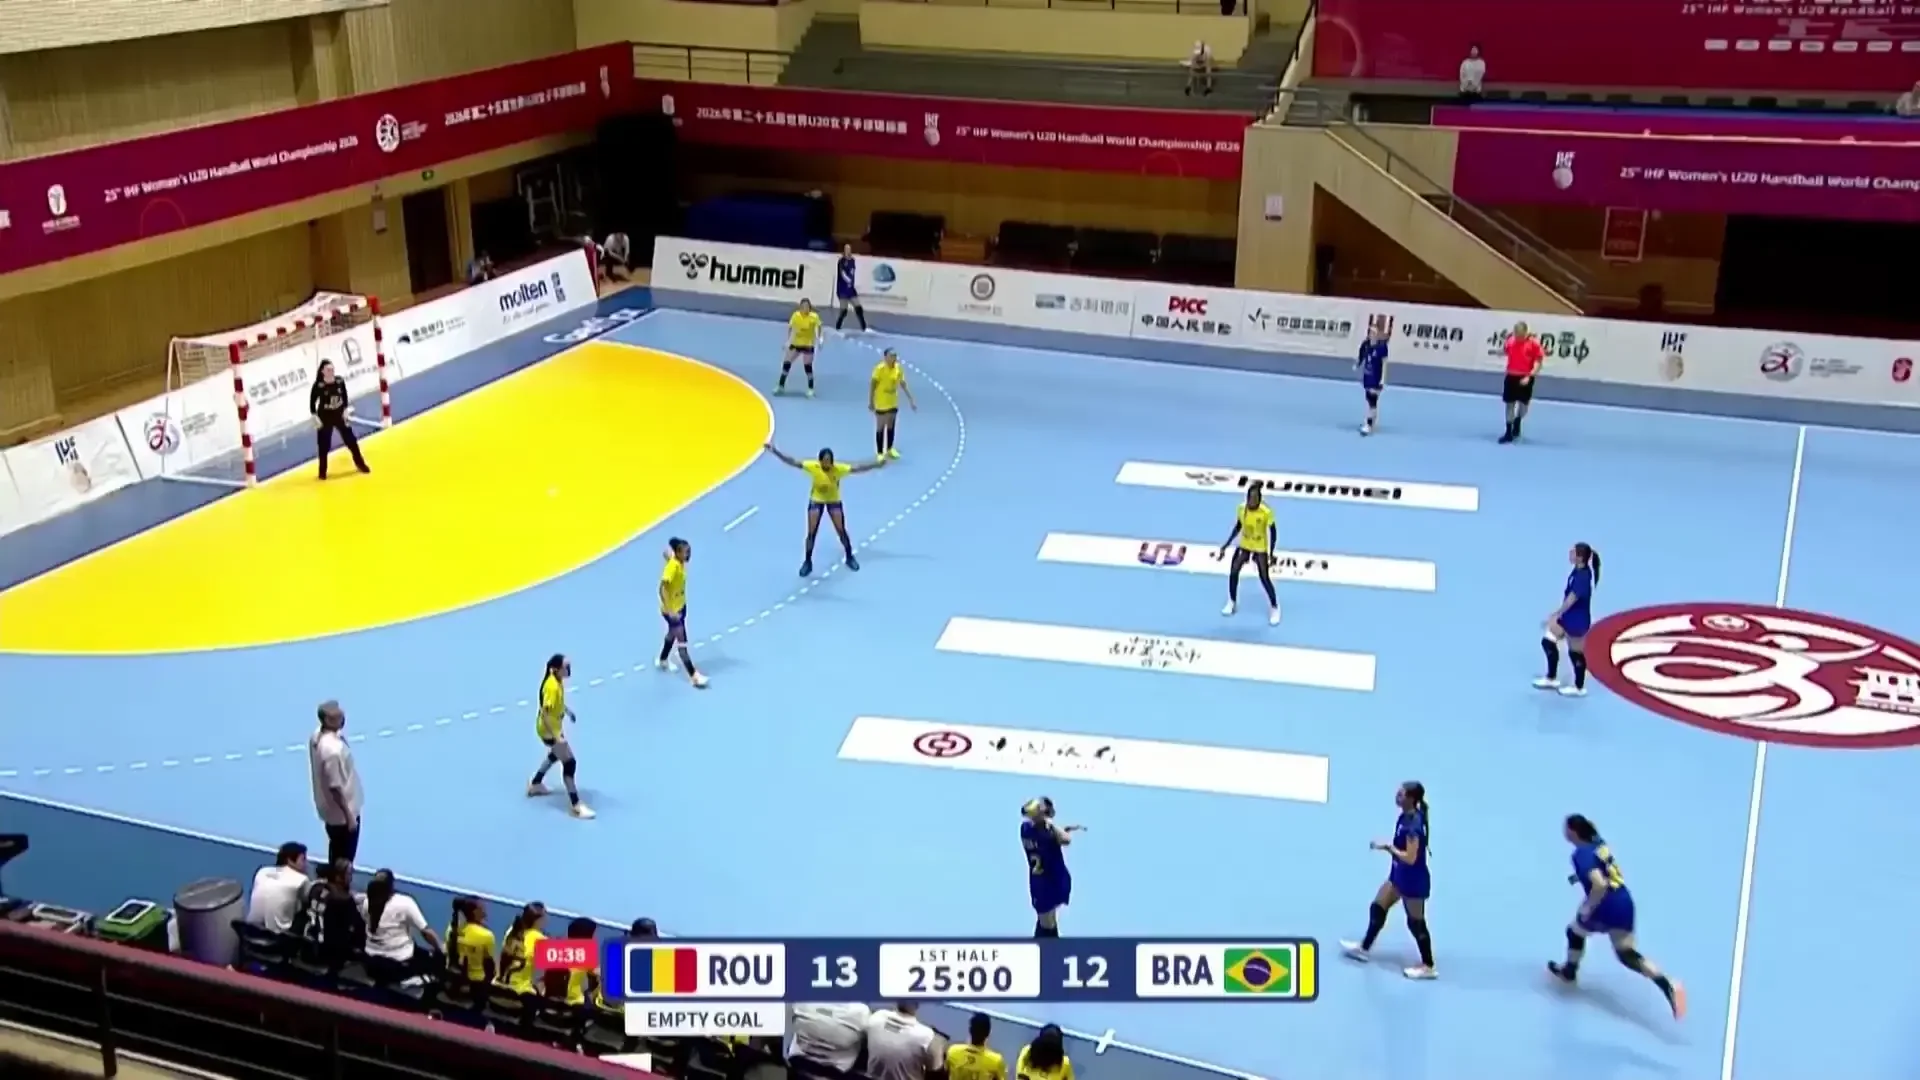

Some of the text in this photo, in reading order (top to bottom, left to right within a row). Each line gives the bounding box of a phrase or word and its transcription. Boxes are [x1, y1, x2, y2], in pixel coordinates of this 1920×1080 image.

[1058, 132, 1103, 145] Handball
[1106, 134, 1136, 147] World
[1138, 136, 1212, 153] Championship
[209, 158, 251, 180] Handball
[251, 151, 278, 169] World
[279, 139, 338, 163] Championship
[1644, 167, 1665, 180] IHF
[1668, 169, 1728, 184] Women's
[1731, 170, 1758, 184] U20
[1761, 171, 1825, 187] Handball
[1827, 173, 1869, 188] World
[709, 256, 805, 290] hummel
[499, 279, 548, 312] molten
[1168, 296, 1208, 315] PICC
[1238, 475, 1402, 500] hummel
